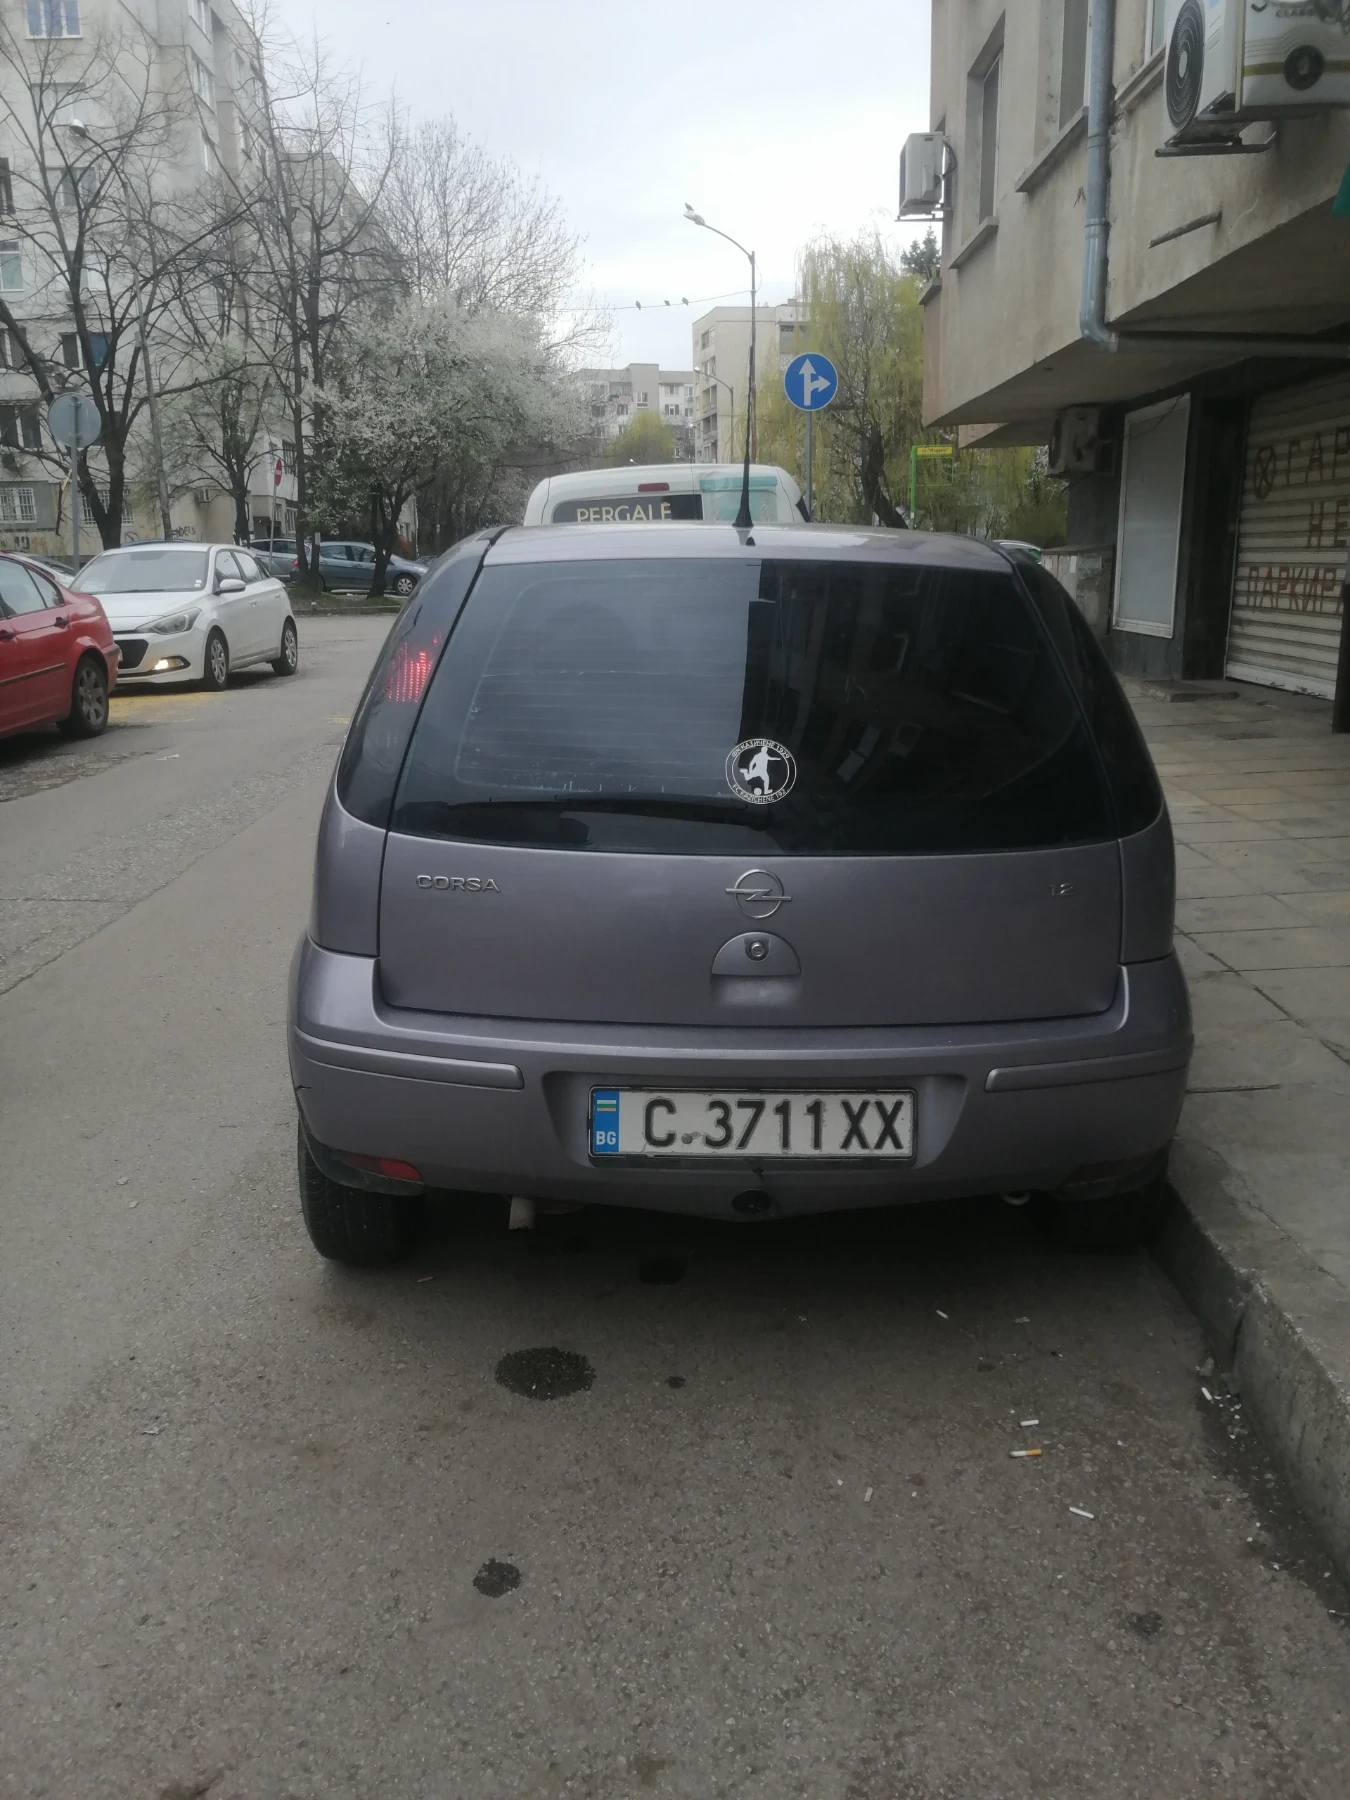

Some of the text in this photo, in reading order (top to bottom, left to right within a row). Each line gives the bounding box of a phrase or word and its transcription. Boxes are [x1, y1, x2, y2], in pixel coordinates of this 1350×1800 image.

[777, 746, 791, 759] 1929
[416, 874, 501, 893] CORSA
[595, 1130, 617, 1146] BG
